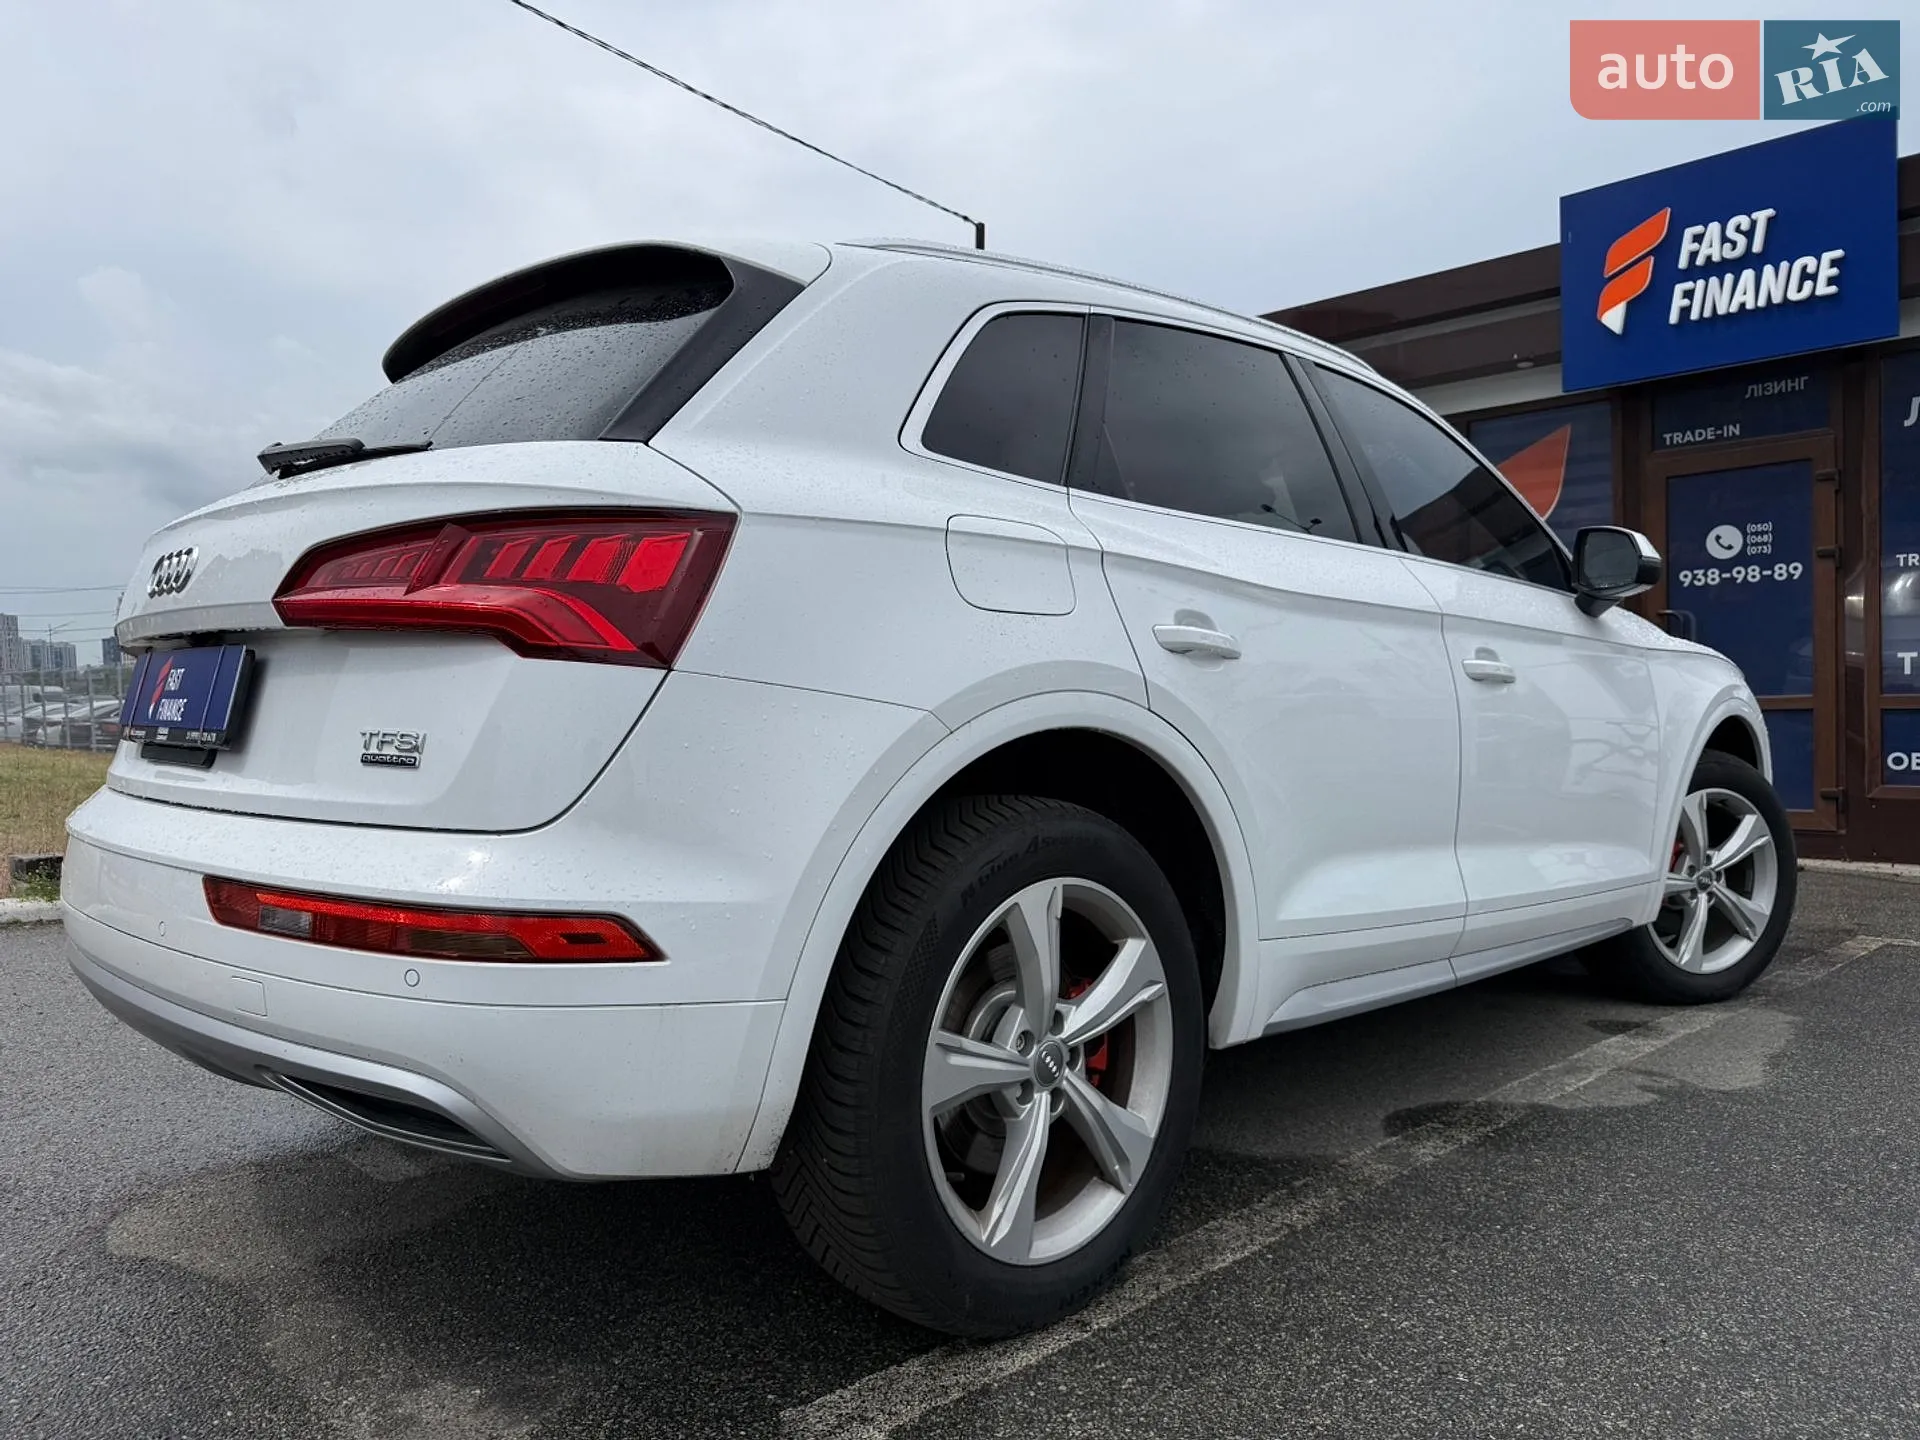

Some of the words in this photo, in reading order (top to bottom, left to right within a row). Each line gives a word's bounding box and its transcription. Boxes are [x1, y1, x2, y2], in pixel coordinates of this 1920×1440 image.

[1678, 208, 1776, 270] FAST
[1668, 249, 1845, 325] FINANCE
[1745, 376, 1809, 399] ЛІЗИНГ
[1663, 424, 1741, 446] TRADE-IN
[1679, 562, 1803, 587] 938-98-89
[359, 730, 427, 755] TFSI
[361, 754, 416, 766] quattro
